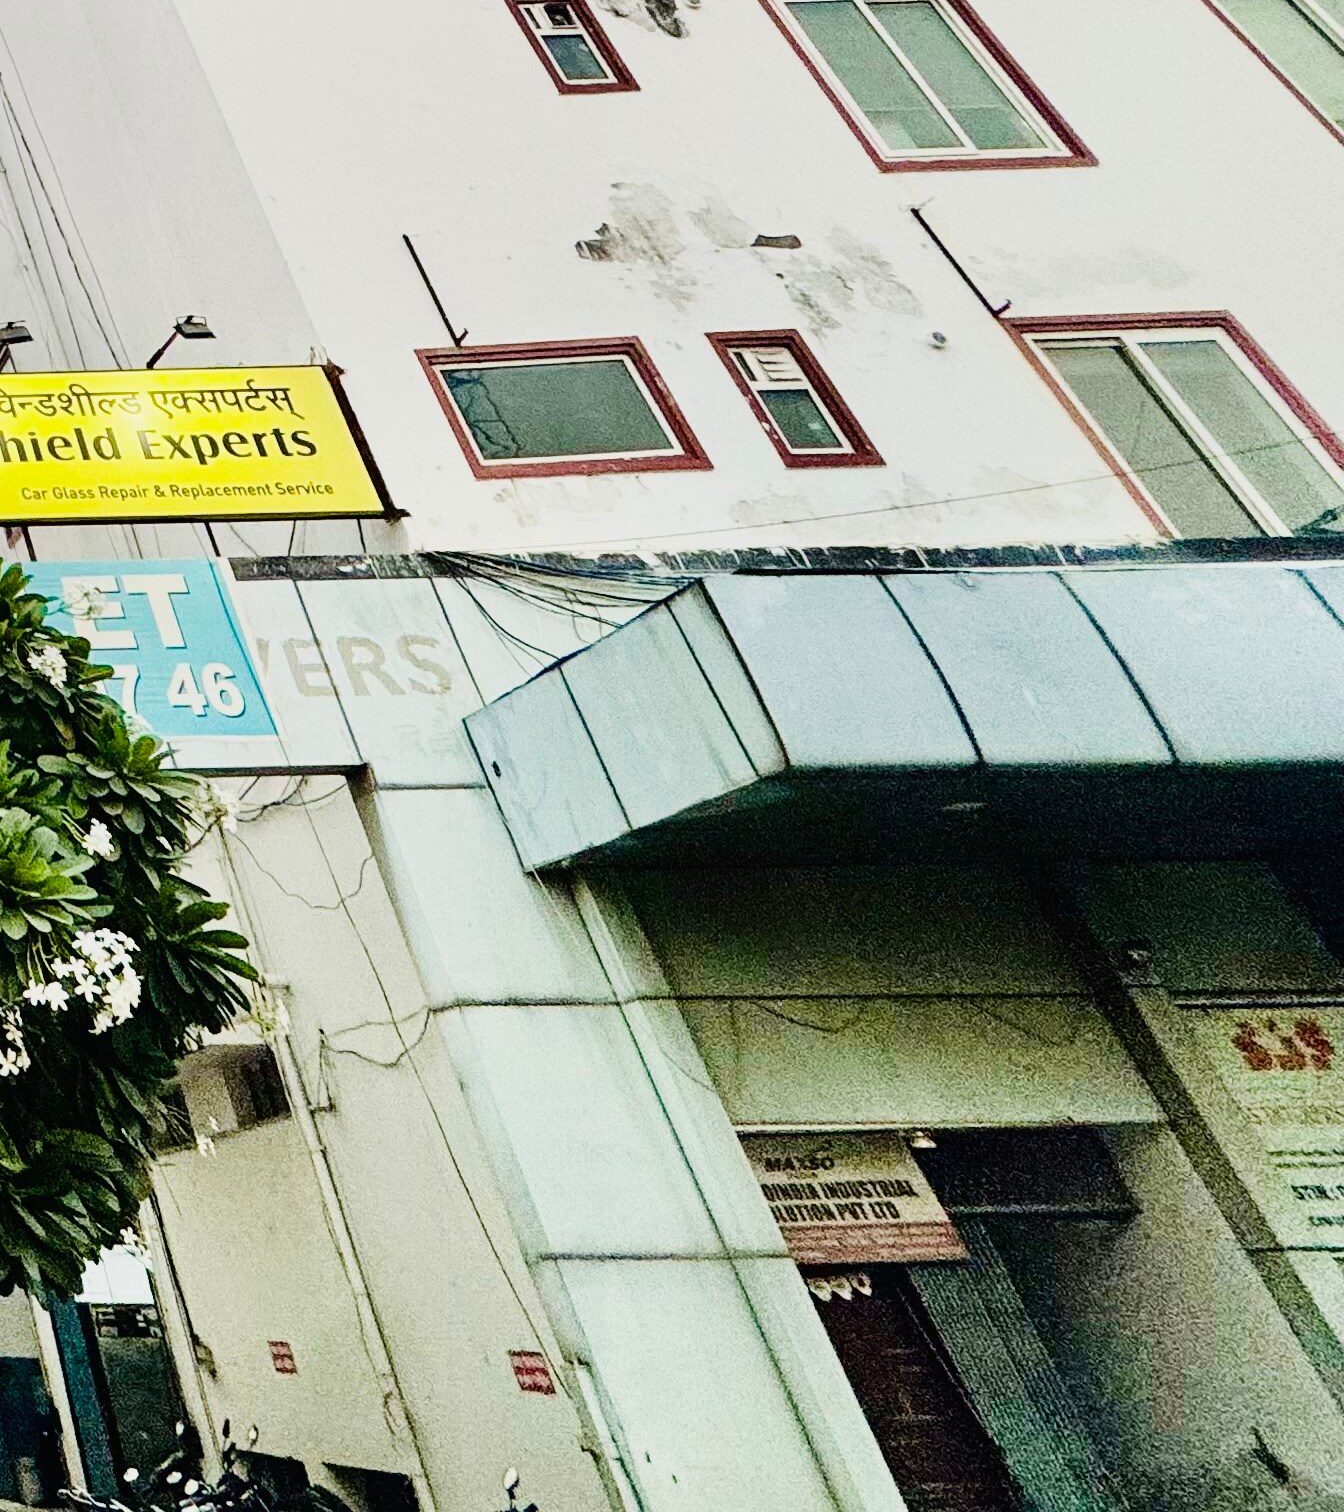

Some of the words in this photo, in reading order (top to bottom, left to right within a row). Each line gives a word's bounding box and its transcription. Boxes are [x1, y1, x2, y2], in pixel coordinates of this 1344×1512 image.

[136, 427, 318, 465] Experts
[21, 486, 47, 500] Car
[52, 485, 96, 500] Glass
[98, 484, 149, 501] Repair
[154, 484, 168, 498] &
[170, 482, 273, 500] Replacement
[276, 480, 334, 496] Service
[166, 662, 247, 717] 46
[820, 1178, 920, 1200] INDUSTRIAL
[836, 1200, 870, 1222] PVT
[869, 1200, 900, 1220] LTD
